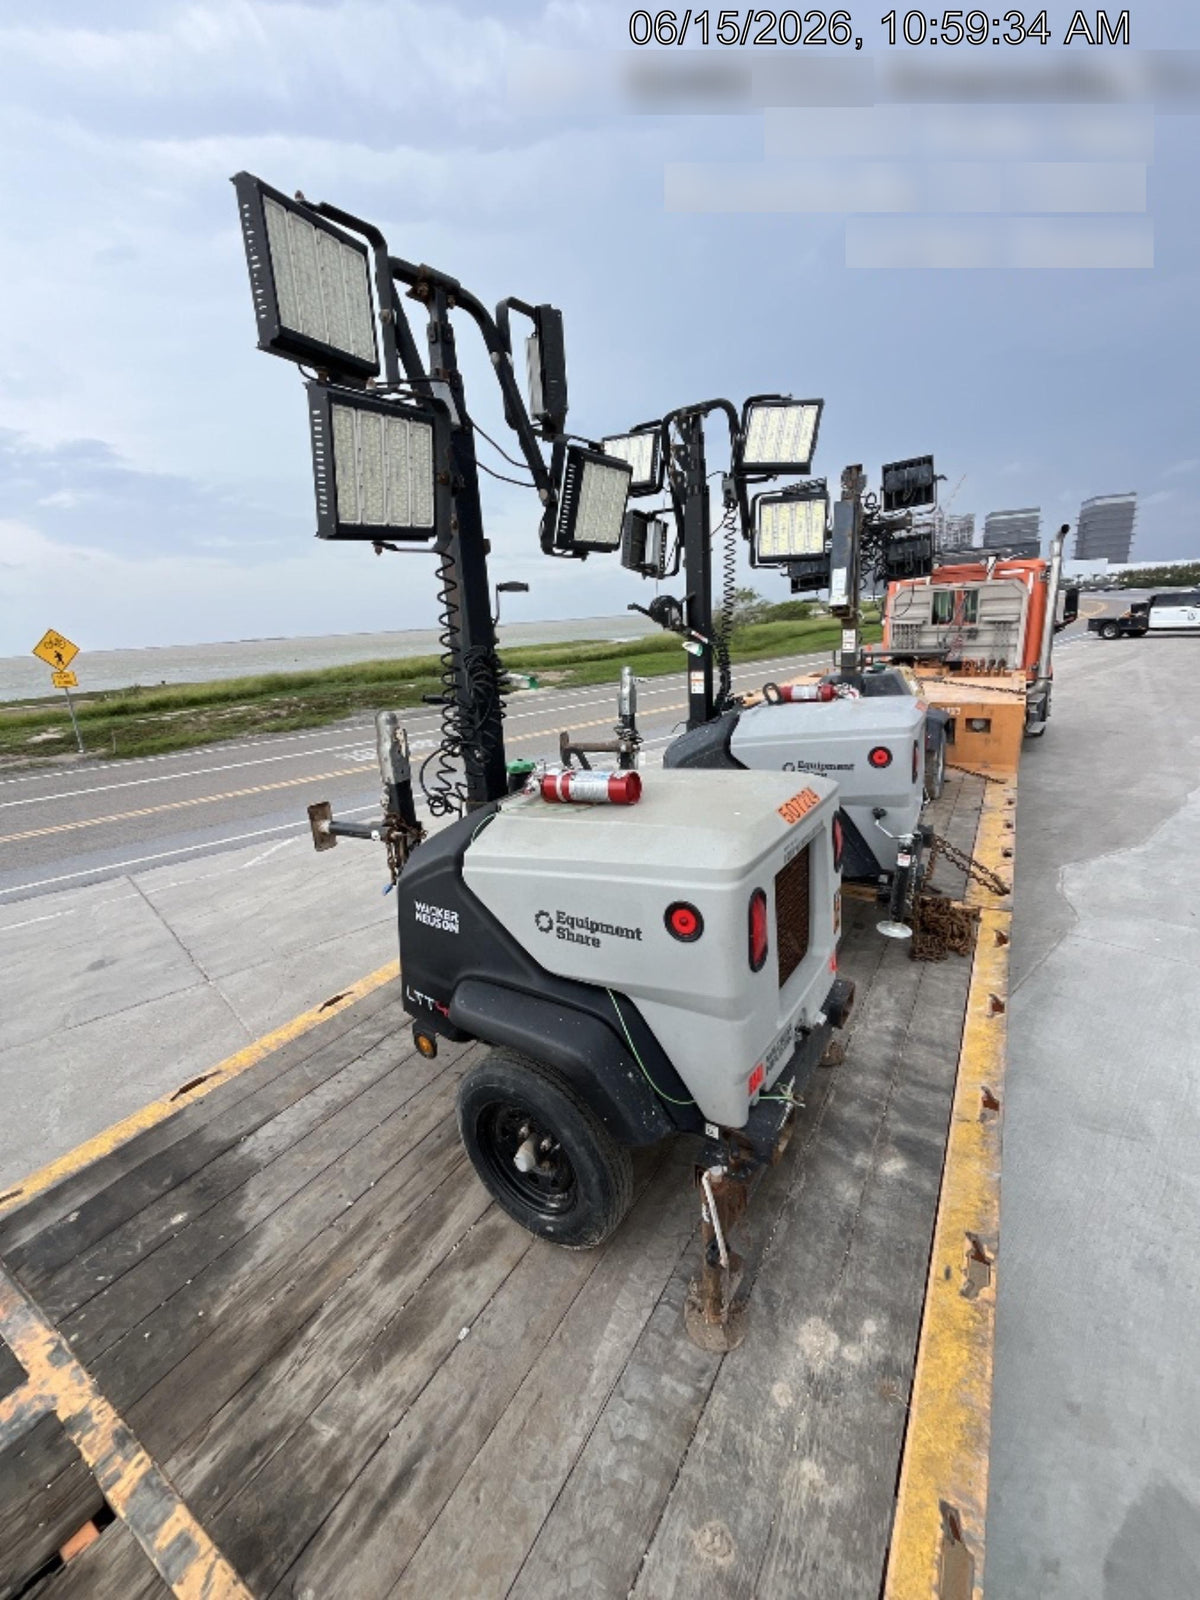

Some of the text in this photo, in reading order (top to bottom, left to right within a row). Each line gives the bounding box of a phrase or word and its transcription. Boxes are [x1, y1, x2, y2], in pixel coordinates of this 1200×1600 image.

[414, 900, 459, 923] WACKER
[415, 910, 459, 934] NEUSON
[556, 910, 642, 941] Equipment
[556, 926, 601, 948] Share
